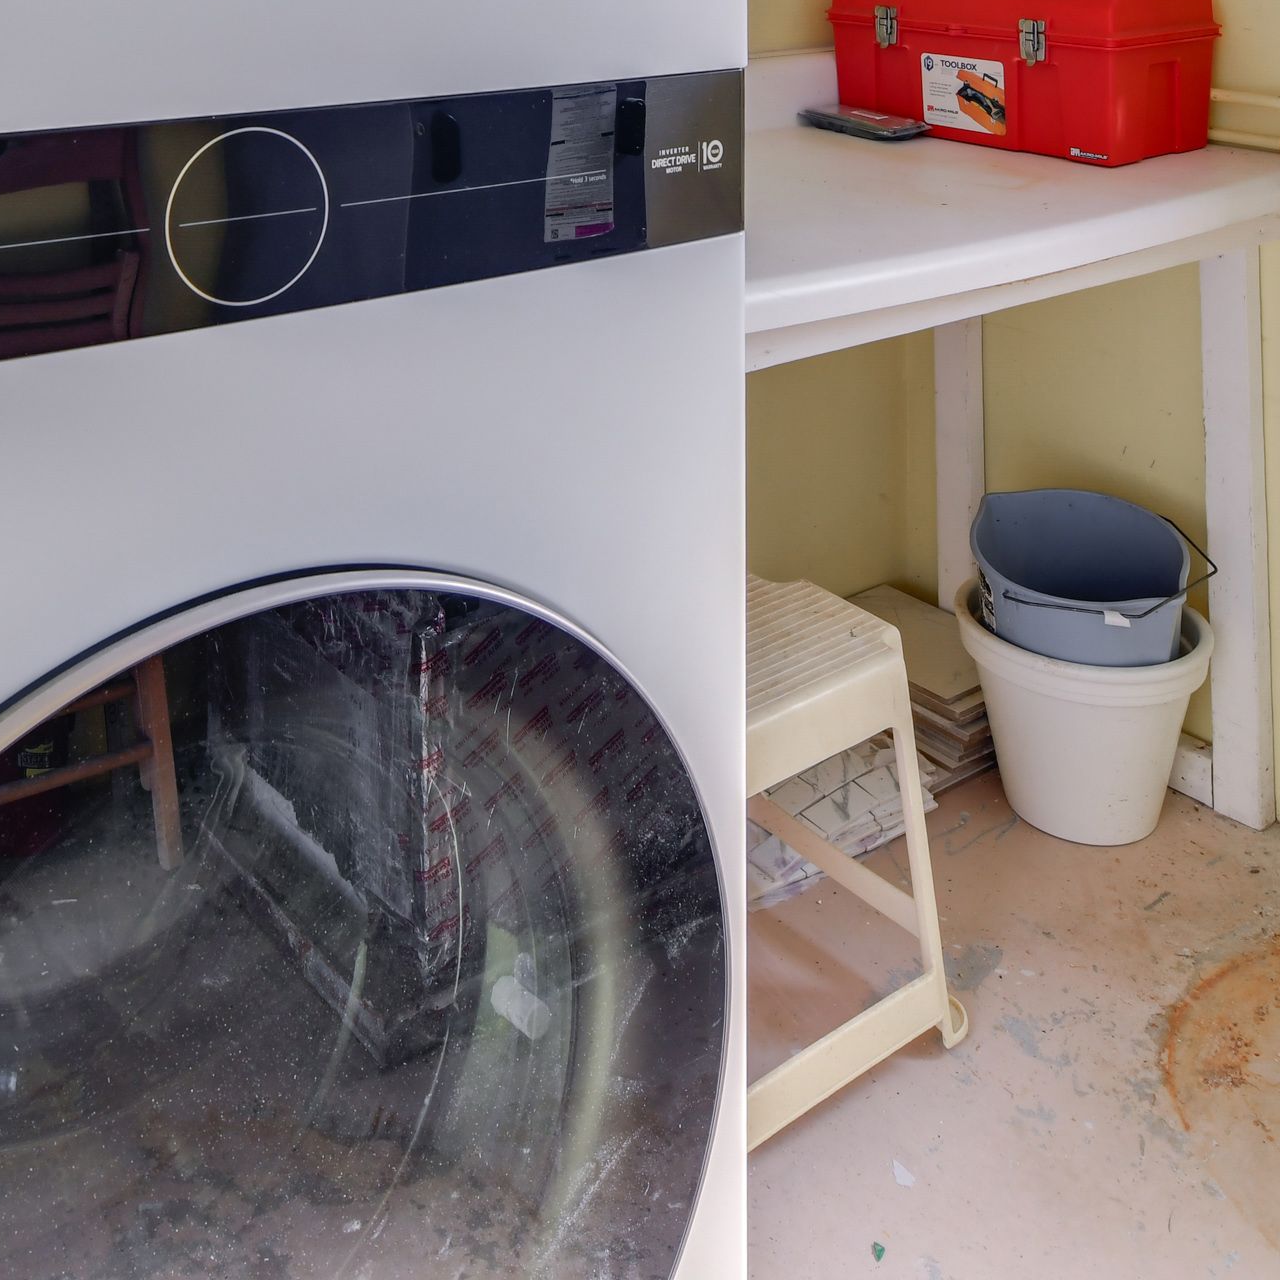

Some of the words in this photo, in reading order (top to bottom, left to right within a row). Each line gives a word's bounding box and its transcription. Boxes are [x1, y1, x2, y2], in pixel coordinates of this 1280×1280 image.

[940, 59, 978, 71] TOOLBOX
[659, 146, 689, 156] INVERTER
[702, 139, 724, 164] 10
[651, 155, 676, 169] DIRECT
[676, 153, 697, 166] DRIVE
[665, 165, 683, 174] MOTOR
